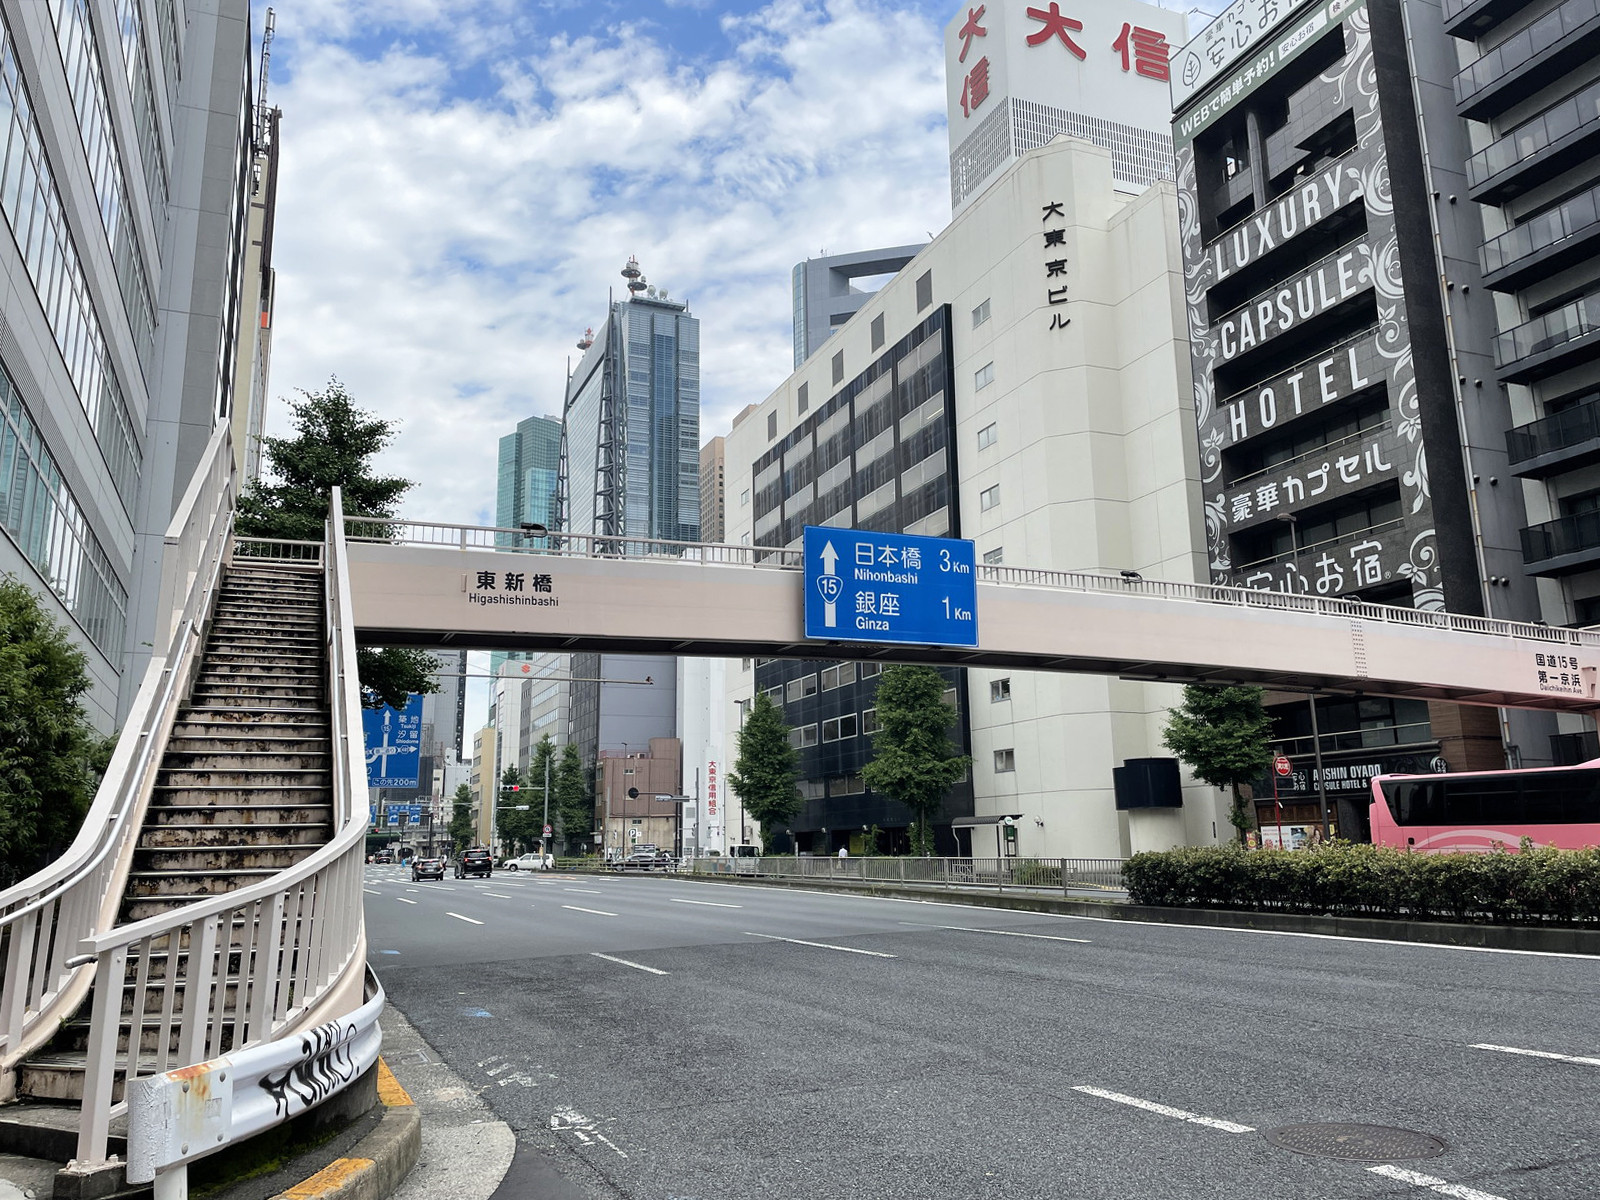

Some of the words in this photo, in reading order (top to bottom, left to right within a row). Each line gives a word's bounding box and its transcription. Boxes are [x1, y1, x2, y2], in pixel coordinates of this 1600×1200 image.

[1024, 2, 1171, 83] 大信
[958, 4, 990, 119] 大信
[1214, 163, 1345, 281] LUXURY
[1042, 201, 1071, 331] 大東京ビル
[1220, 251, 1358, 360] CAPSULE
[1229, 346, 1369, 443] HOTEL
[1230, 443, 1392, 524] 豪華カプセル
[855, 542, 922, 570] 日本橋
[939, 549, 951, 572] 3
[953, 562, 970, 574] Km
[476, 570, 553, 593] 東新橋
[821, 579, 838, 595] 15
[854, 567, 918, 585] Nihonbashi
[468, 592, 559, 607] Higashishinbashi
[855, 590, 901, 616] 銀座
[942, 596, 951, 620] 1
[954, 607, 972, 621] Km
[855, 616, 890, 632] Ginza
[1536, 653, 1578, 670] 国道15号
[1537, 670, 1582, 687] 第一京浜
[372, 779, 417, 787] この先200m
[1349, 763, 1382, 778] OYADO
[708, 761, 716, 815] 大東京信用組合
[1341, 779, 1361, 790] HOTEL
